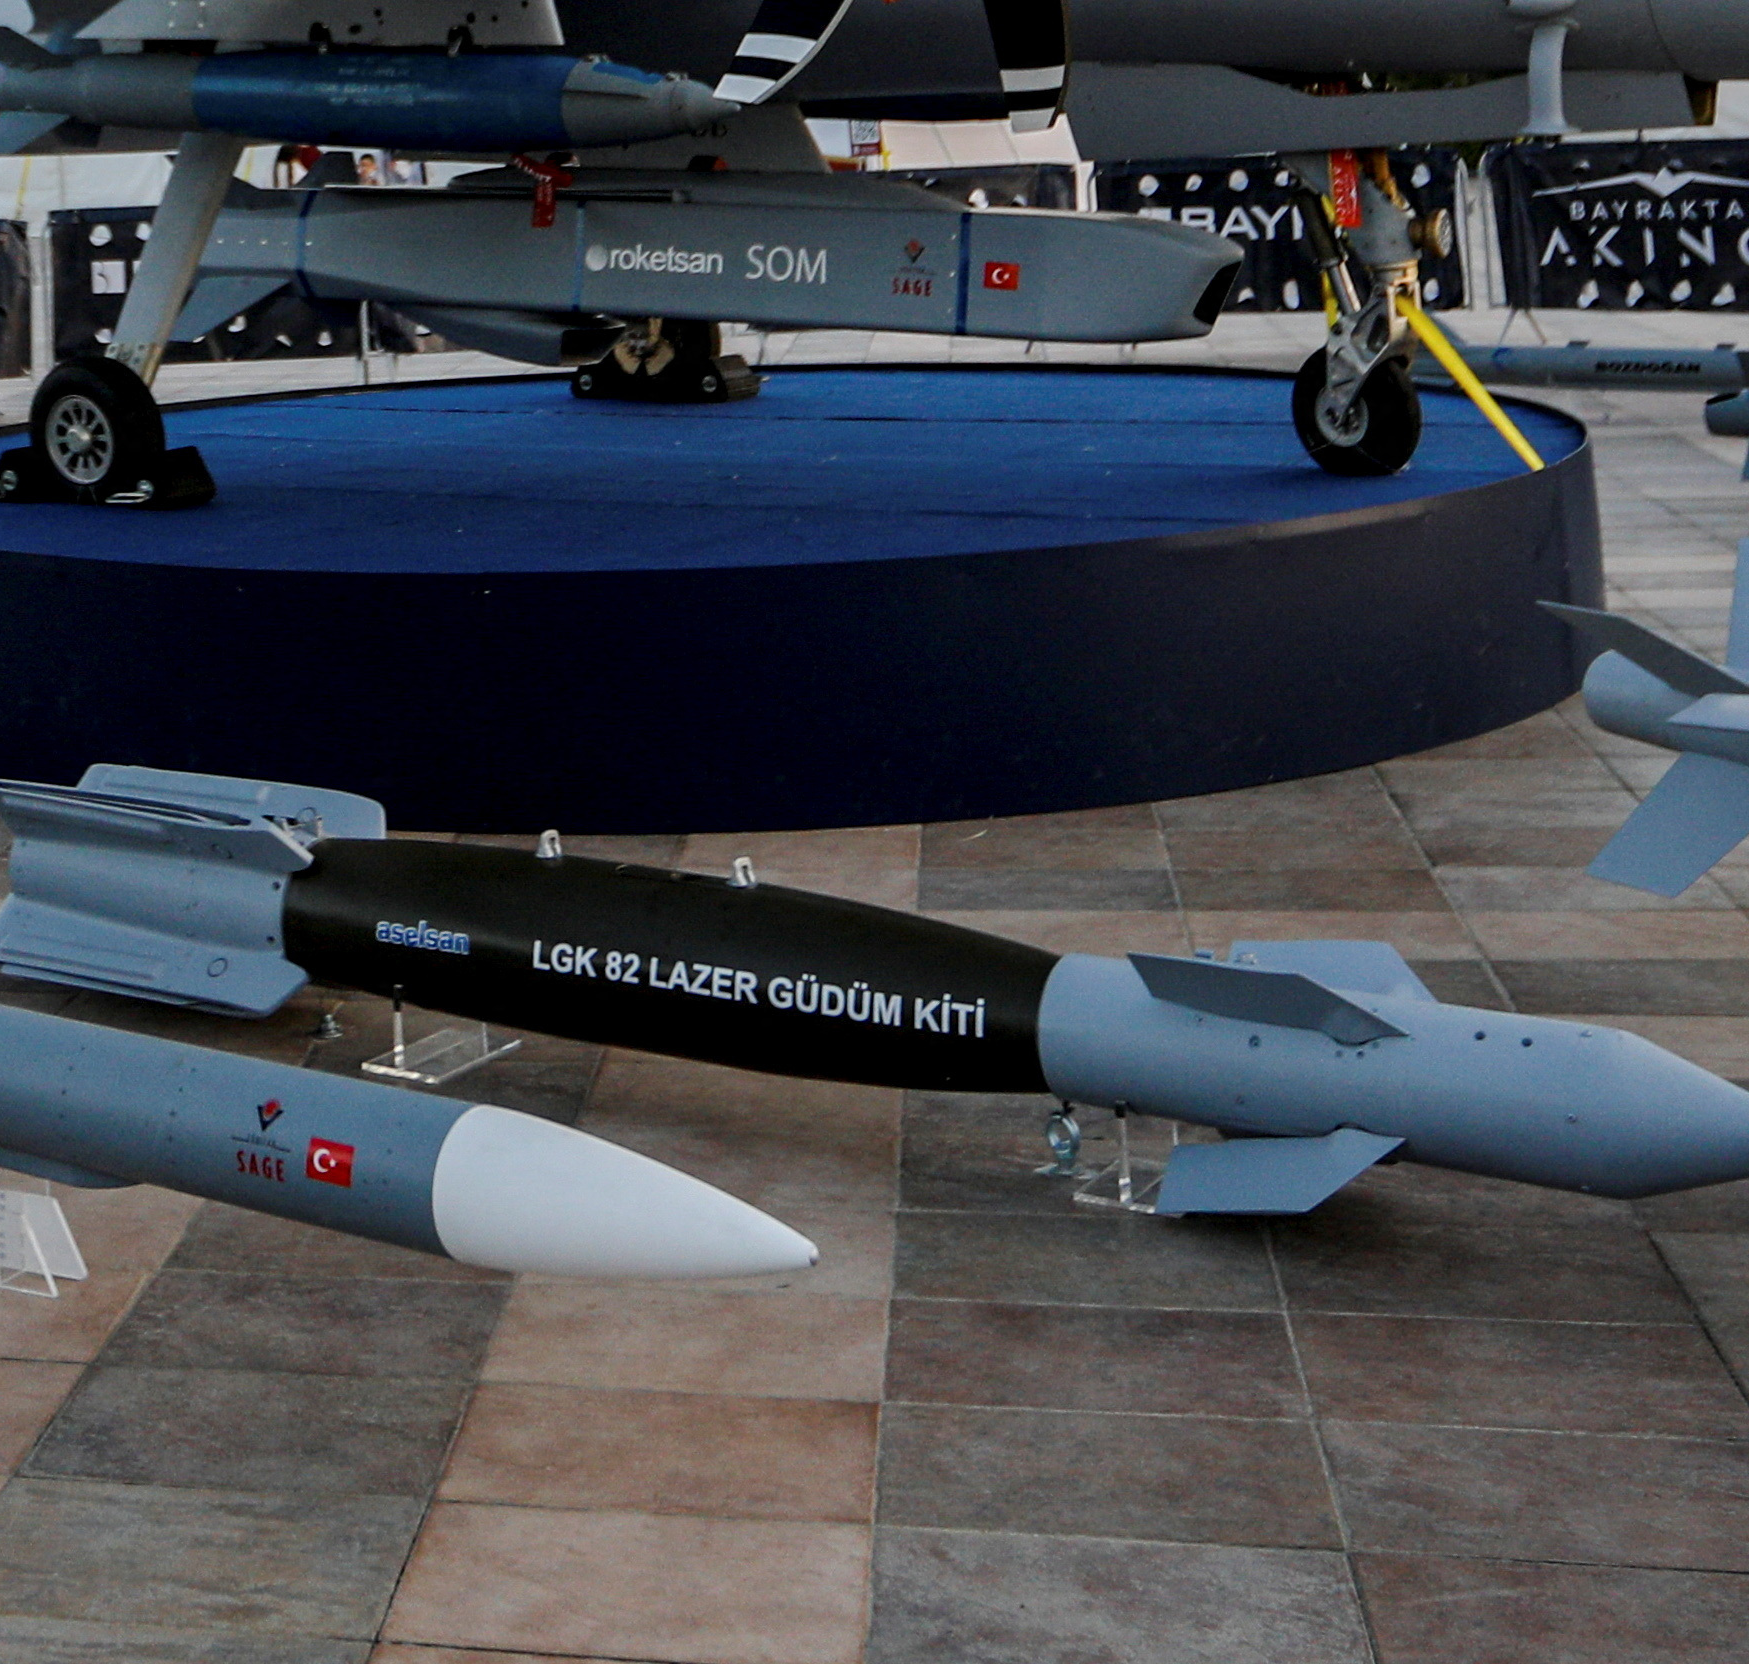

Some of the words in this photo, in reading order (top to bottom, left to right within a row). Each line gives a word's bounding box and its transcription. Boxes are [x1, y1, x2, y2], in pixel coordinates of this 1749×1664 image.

[608, 242, 724, 275] roketsan
[744, 243, 828, 285] SOM
[892, 277, 934, 298] SAGE
[375, 919, 471, 956] aselsan
[531, 939, 599, 978] LGK
[604, 950, 642, 984] 82
[647, 956, 759, 1005] LAZER
[766, 973, 903, 1028] GÜDÜM
[913, 992, 986, 1039] KİTİ
[236, 1150, 286, 1183] SAGE
